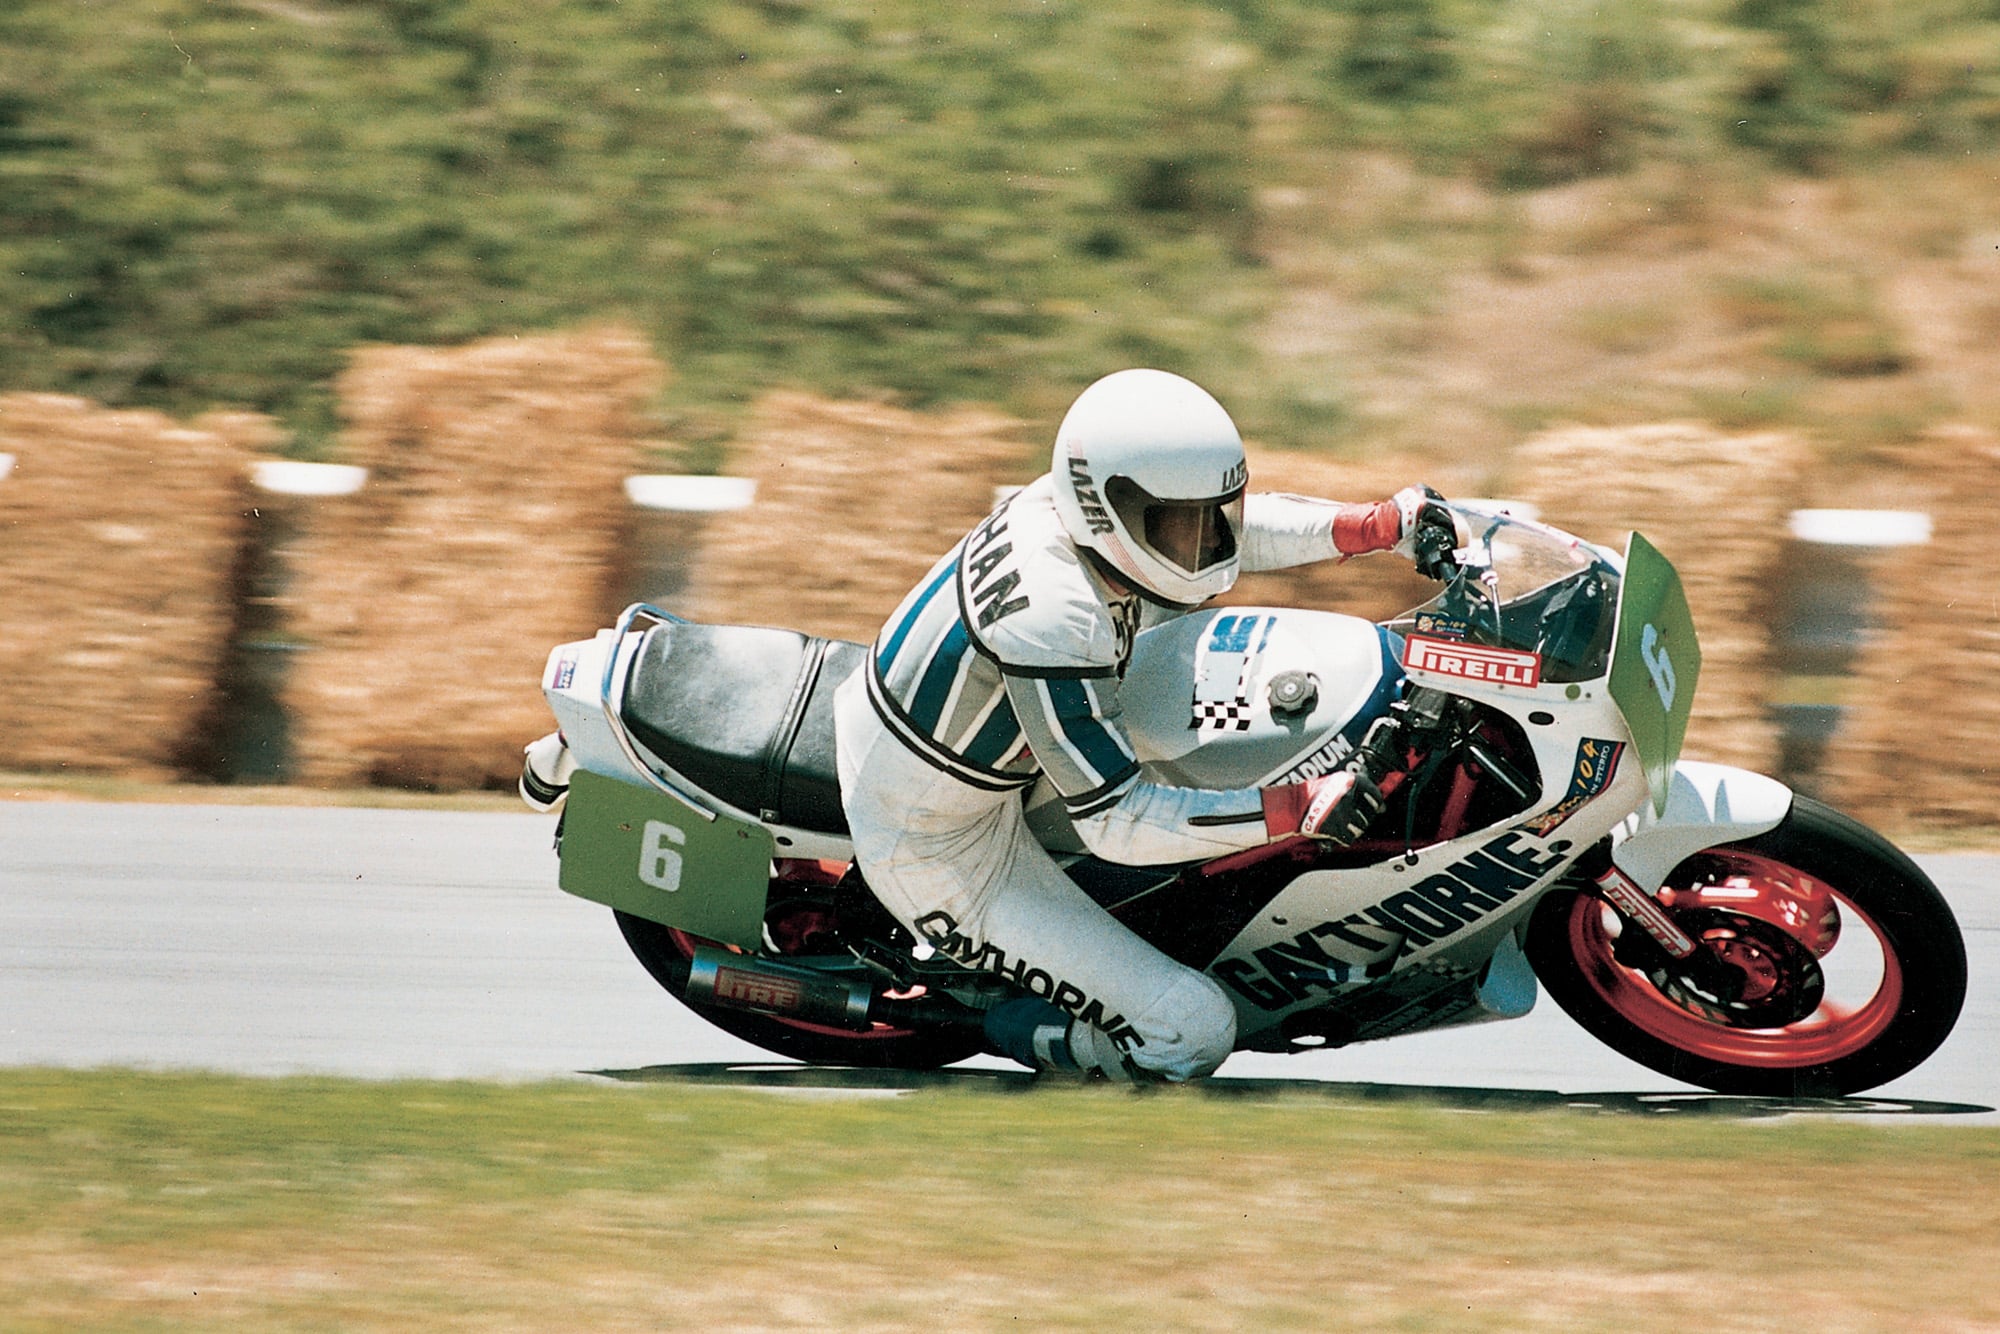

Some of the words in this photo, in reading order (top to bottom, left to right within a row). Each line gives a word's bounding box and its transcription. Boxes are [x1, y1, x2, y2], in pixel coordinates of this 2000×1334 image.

[1068, 457, 1115, 535] LAZER
[1221, 457, 1246, 493] LAZE
[969, 490, 1030, 630] HAN
[1408, 638, 1537, 684] PIRELLI
[1641, 623, 1676, 712] 6
[1576, 740, 1600, 790] 104
[1594, 745, 1611, 783] STEREO
[638, 820, 686, 892] 6
